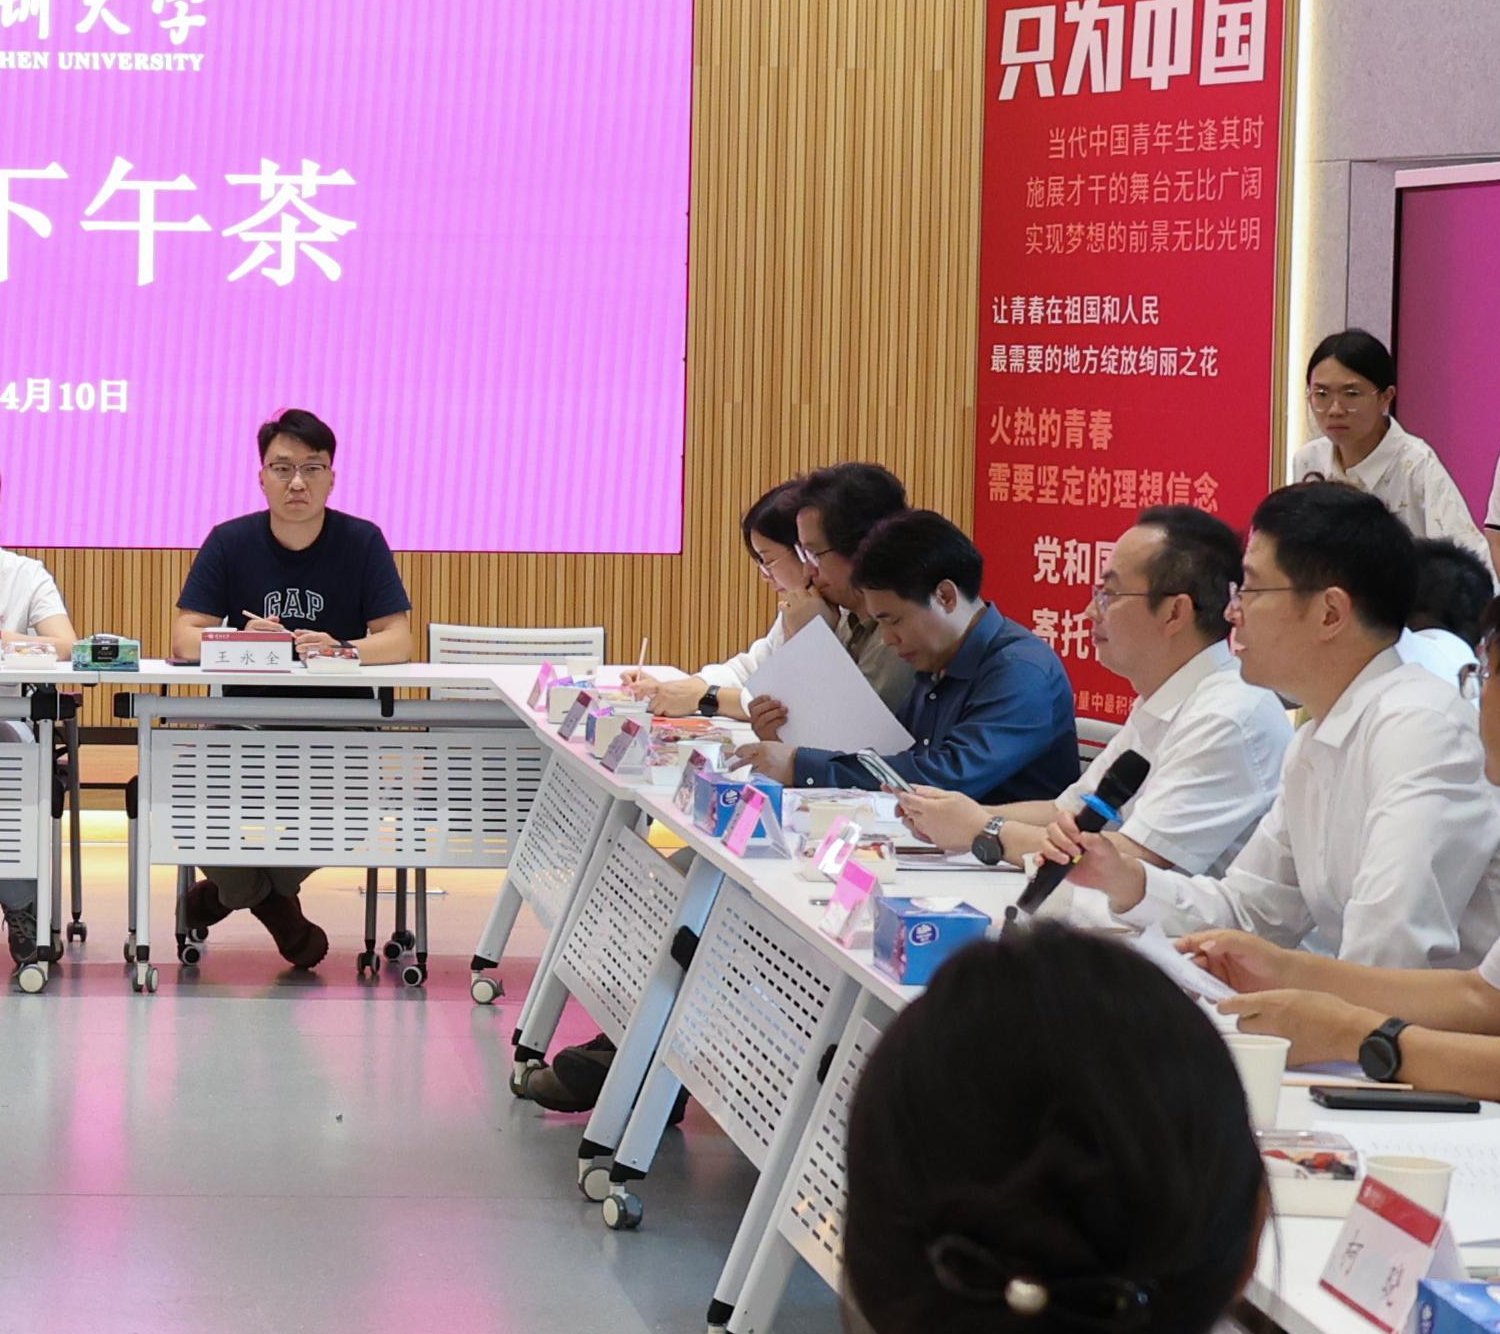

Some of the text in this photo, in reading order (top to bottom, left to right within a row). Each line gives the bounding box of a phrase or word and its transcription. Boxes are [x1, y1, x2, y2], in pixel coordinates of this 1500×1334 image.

[58, 51, 205, 73] UNIVERSITY
[1047, 116, 1264, 162] 当代中国青年生逢其时
[1026, 166, 1262, 209] 施展才干的舞台无比广阔
[1025, 216, 1261, 256] 实现梦想的前景无比光明
[991, 294, 1160, 327] 让青春在祖国和人民
[990, 343, 1219, 379] 最需要的地方绽放绚丽之花
[989, 406, 1114, 452] 火热的青春
[988, 462, 1220, 514] 需要坚定的理想信念
[264, 588, 324, 621] GAP
[1032, 608, 1100, 661] 寄托
[215, 650, 280, 666] 王永全
